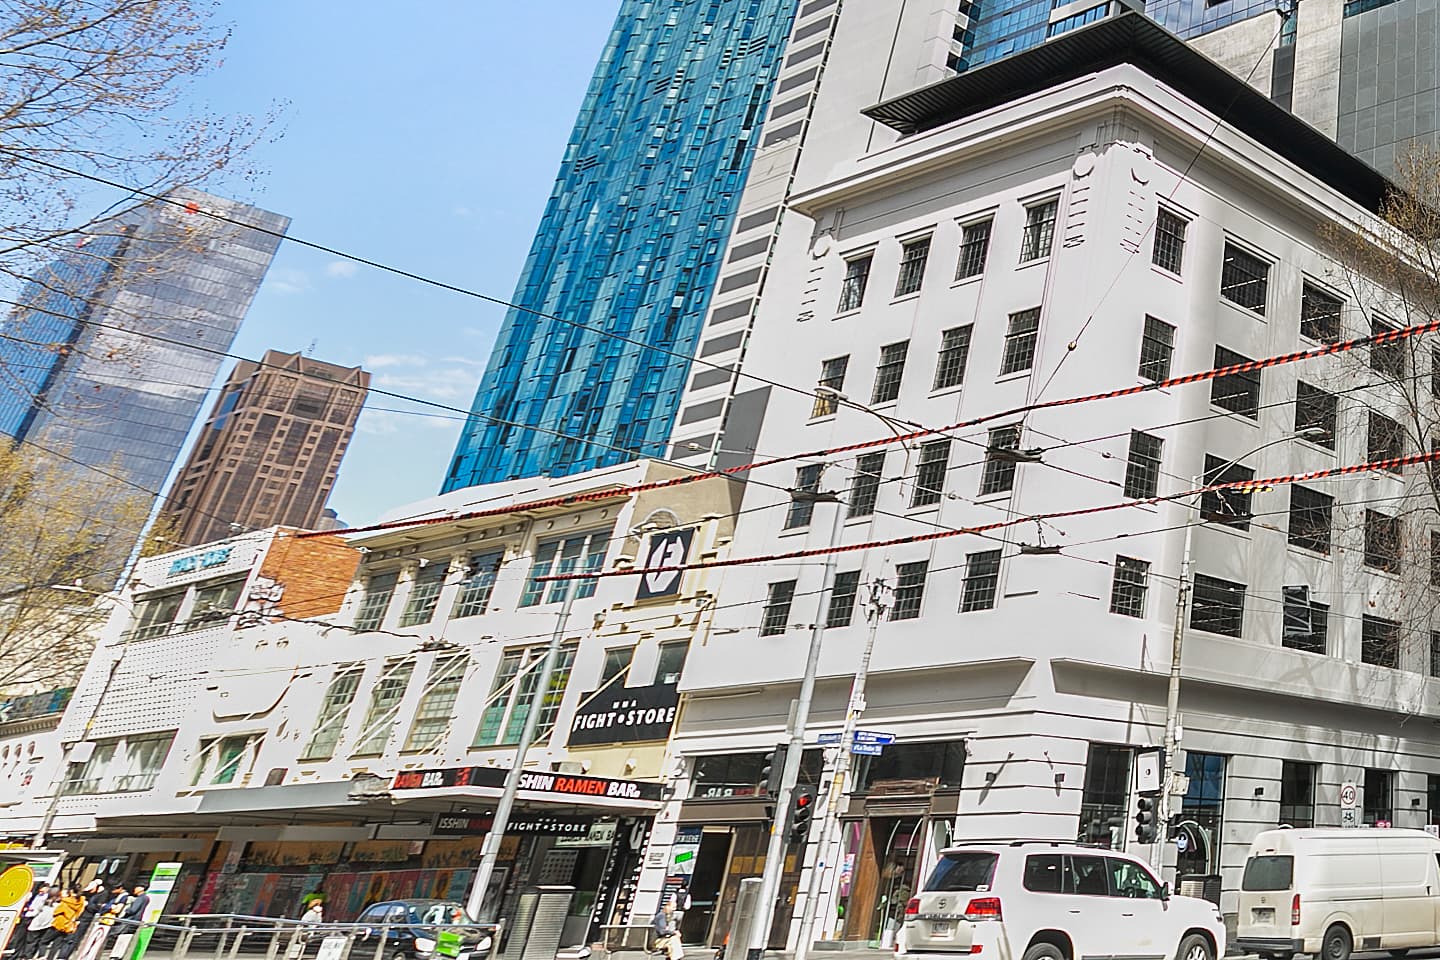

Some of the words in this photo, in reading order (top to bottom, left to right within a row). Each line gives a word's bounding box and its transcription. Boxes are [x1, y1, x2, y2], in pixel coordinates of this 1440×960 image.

[572, 712, 616, 732] FIGHT
[625, 706, 676, 726] STORE
[503, 772, 555, 791] ISHIN
[554, 777, 607, 795] RAMEN
[1343, 791, 1354, 800] 40
[438, 817, 469, 829] ISSHIN
[507, 821, 541, 831] FIGHT
[550, 823, 587, 832] STORE
